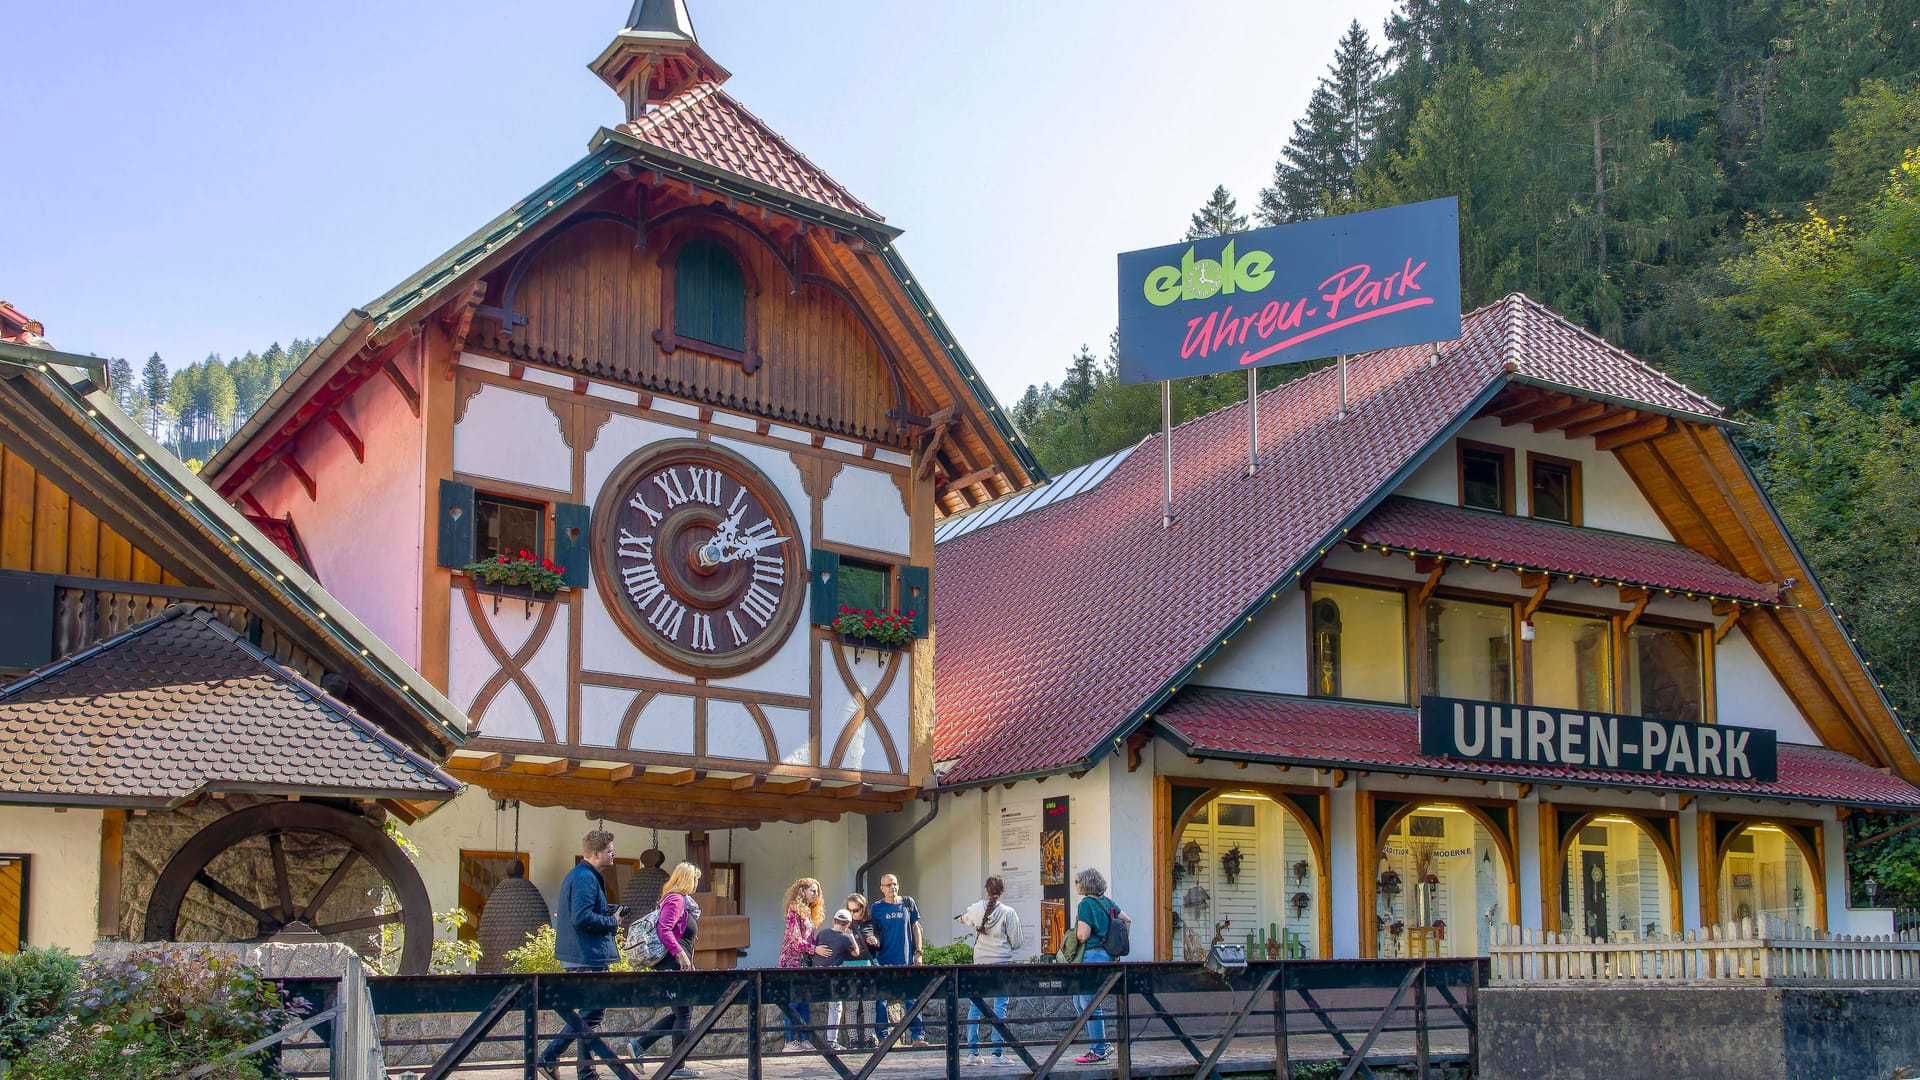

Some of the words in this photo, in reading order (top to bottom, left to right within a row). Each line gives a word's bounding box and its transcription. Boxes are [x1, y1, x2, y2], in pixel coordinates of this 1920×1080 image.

[1143, 238, 1275, 307] eble
[653, 467, 690, 509] XI
[688, 465, 723, 507] XII
[629, 491, 664, 527] X
[617, 527, 654, 561] IX
[621, 562, 666, 611] VIII
[752, 555, 785, 586] III
[648, 593, 687, 641] VII
[739, 581, 780, 629] IIII
[691, 612, 716, 651] VI
[725, 610, 749, 647] V
[1453, 702, 1751, 778] UHREN-PARK
[1433, 847, 1472, 857] MODERNE
